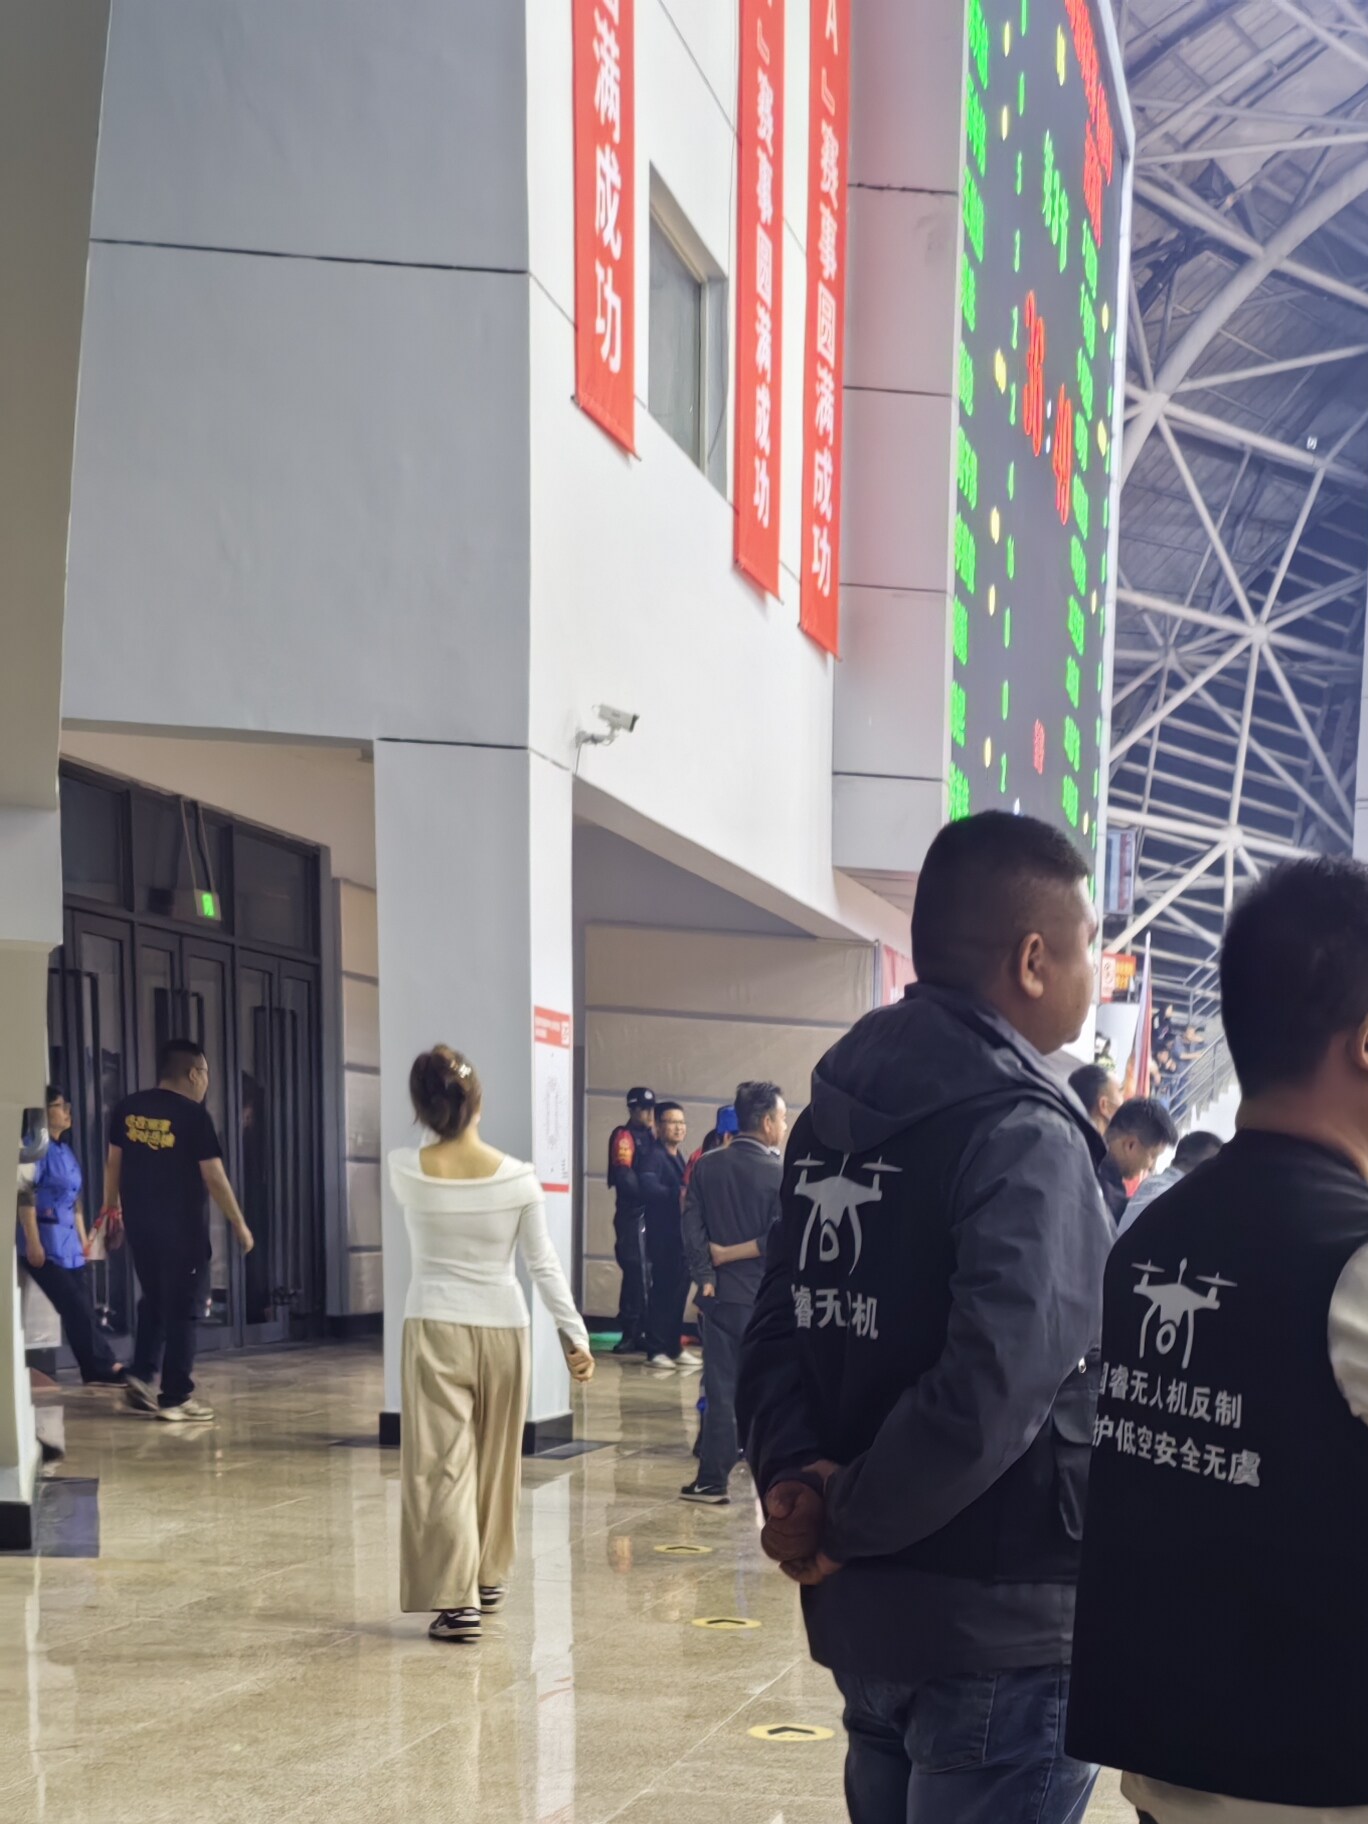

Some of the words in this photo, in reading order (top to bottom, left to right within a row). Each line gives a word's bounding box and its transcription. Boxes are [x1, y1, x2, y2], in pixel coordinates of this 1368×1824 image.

[593, 0, 623, 374] 满成功
[753, 0, 775, 529] 』赛事圆满成功
[790, 1284, 879, 1340] 睿无机
